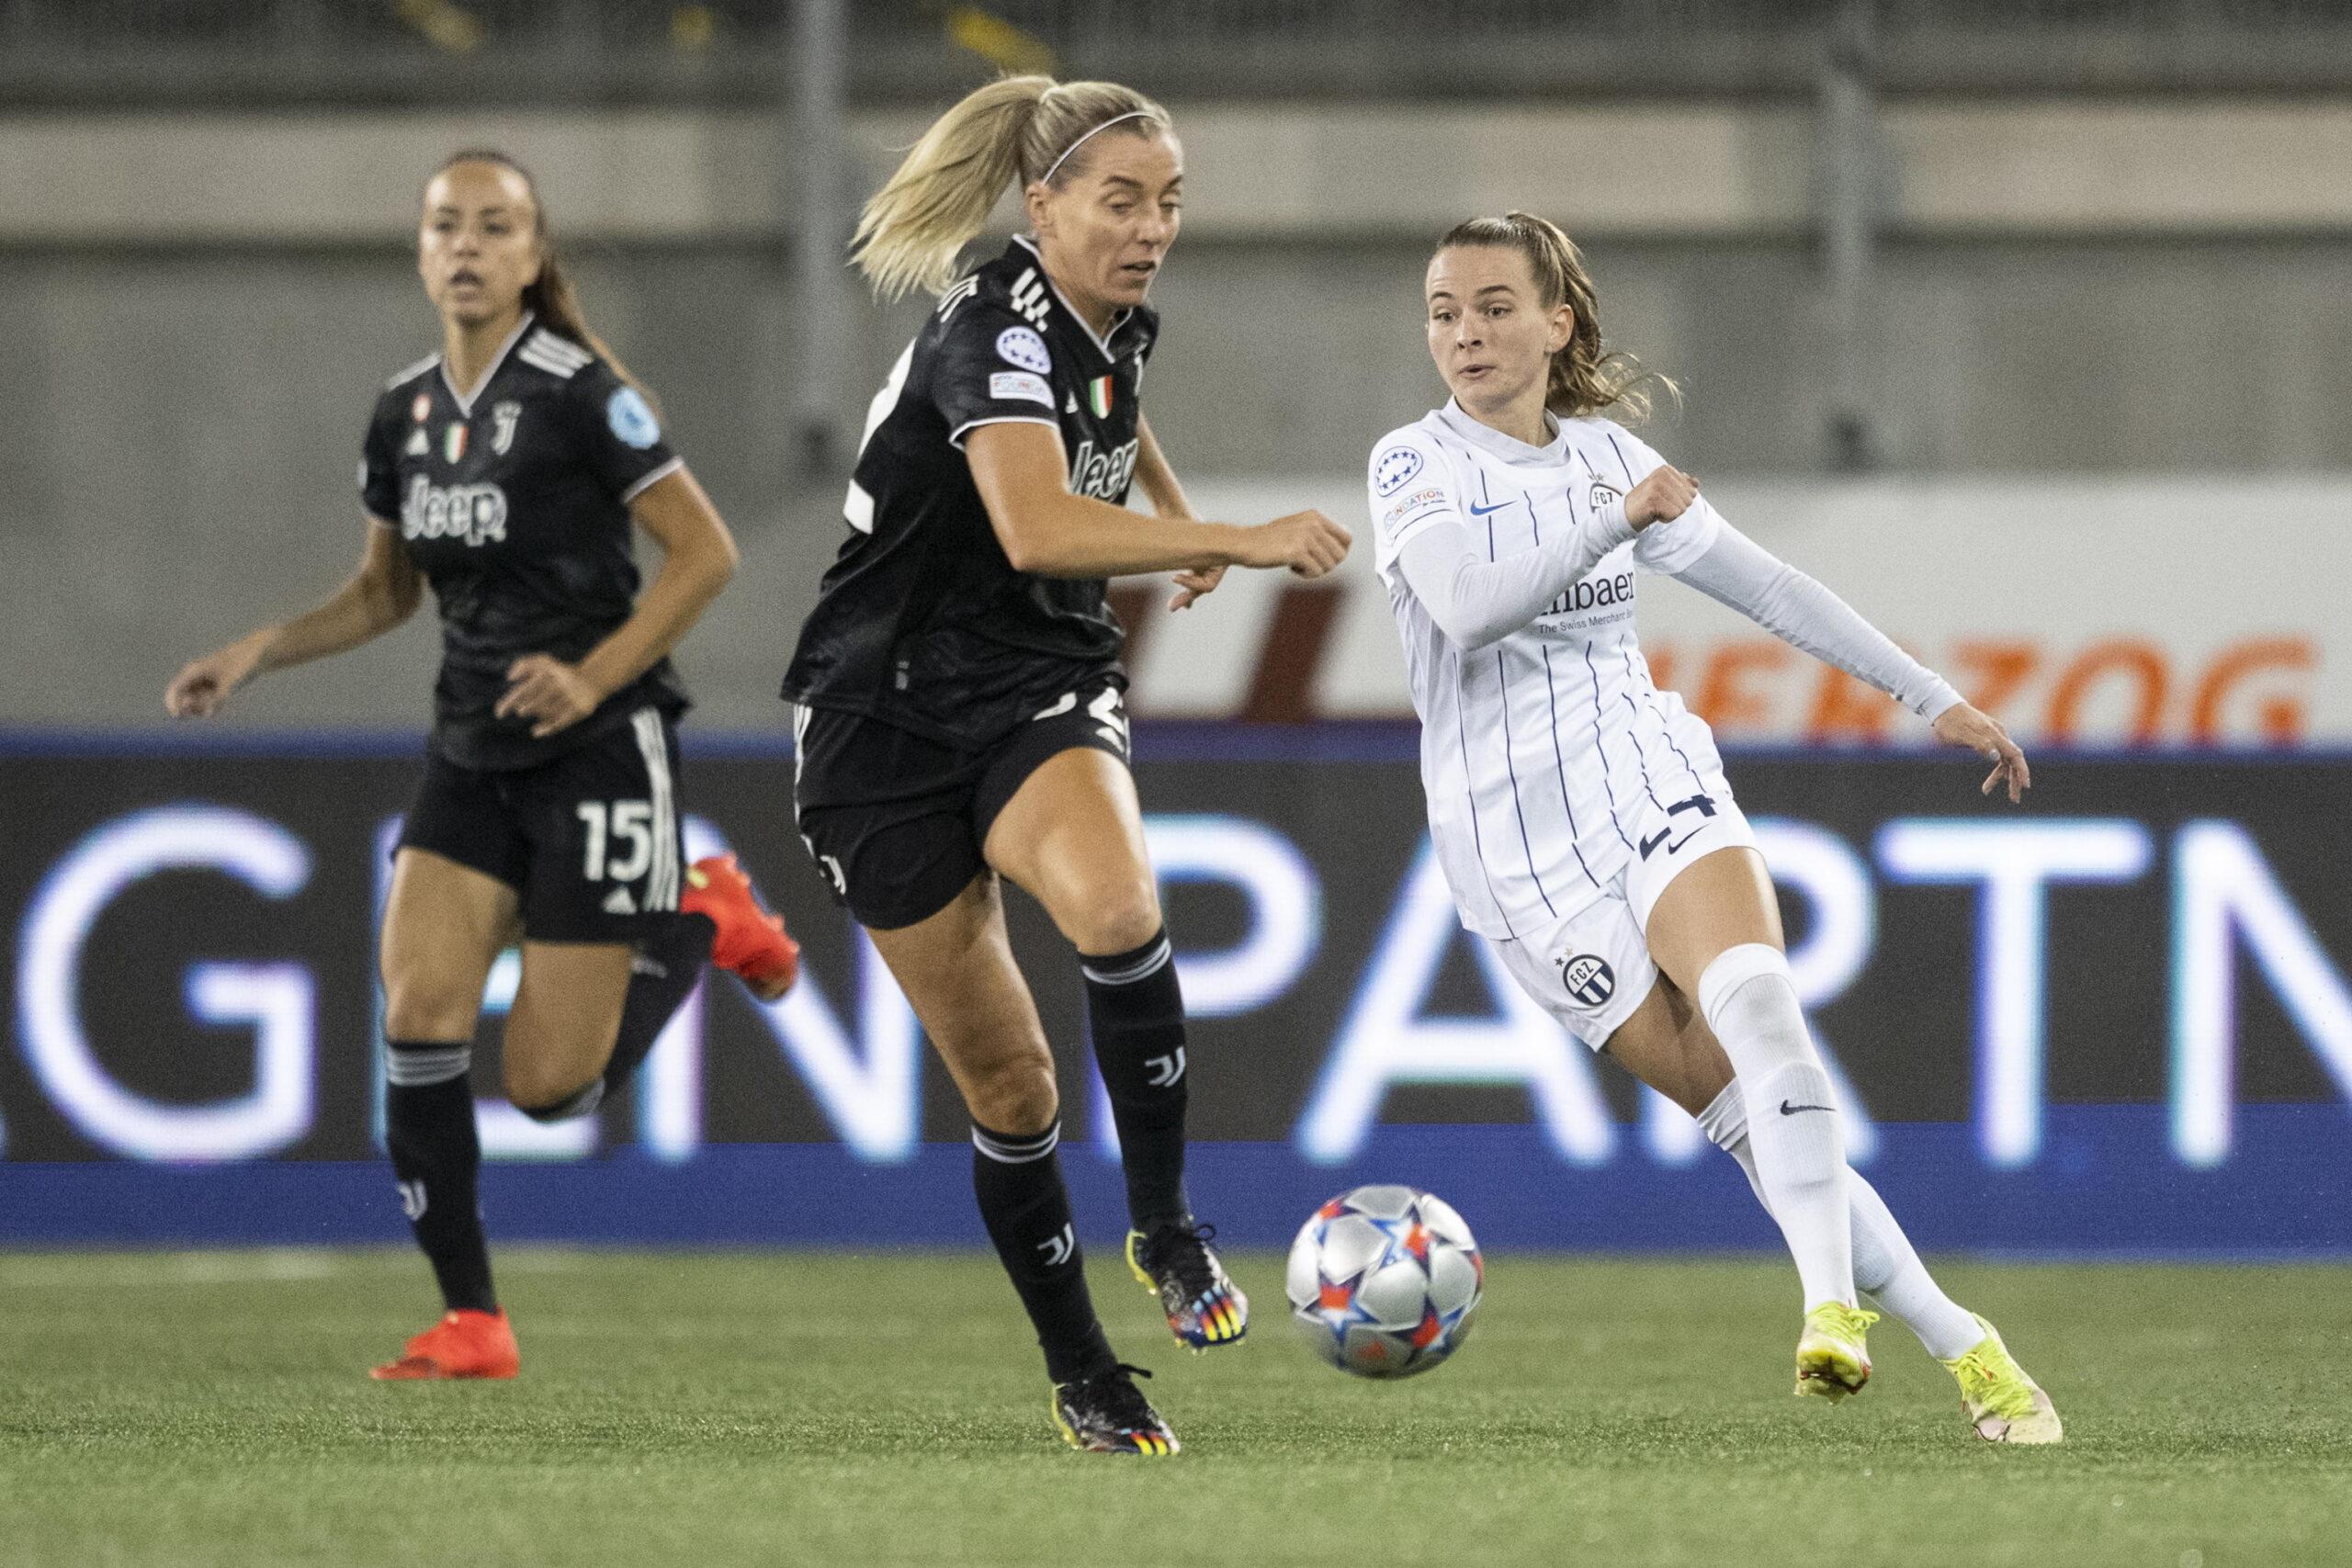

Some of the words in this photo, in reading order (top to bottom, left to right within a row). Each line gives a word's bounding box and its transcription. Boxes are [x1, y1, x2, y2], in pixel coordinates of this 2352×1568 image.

[401, 473, 507, 547] Jeep
[1539, 625, 1558, 634] The
[1559, 619, 1588, 631] Swiss
[1647, 634, 2319, 746] ERZOG
[576, 798, 652, 882] 15
[1569, 961, 1594, 987] FCZ
